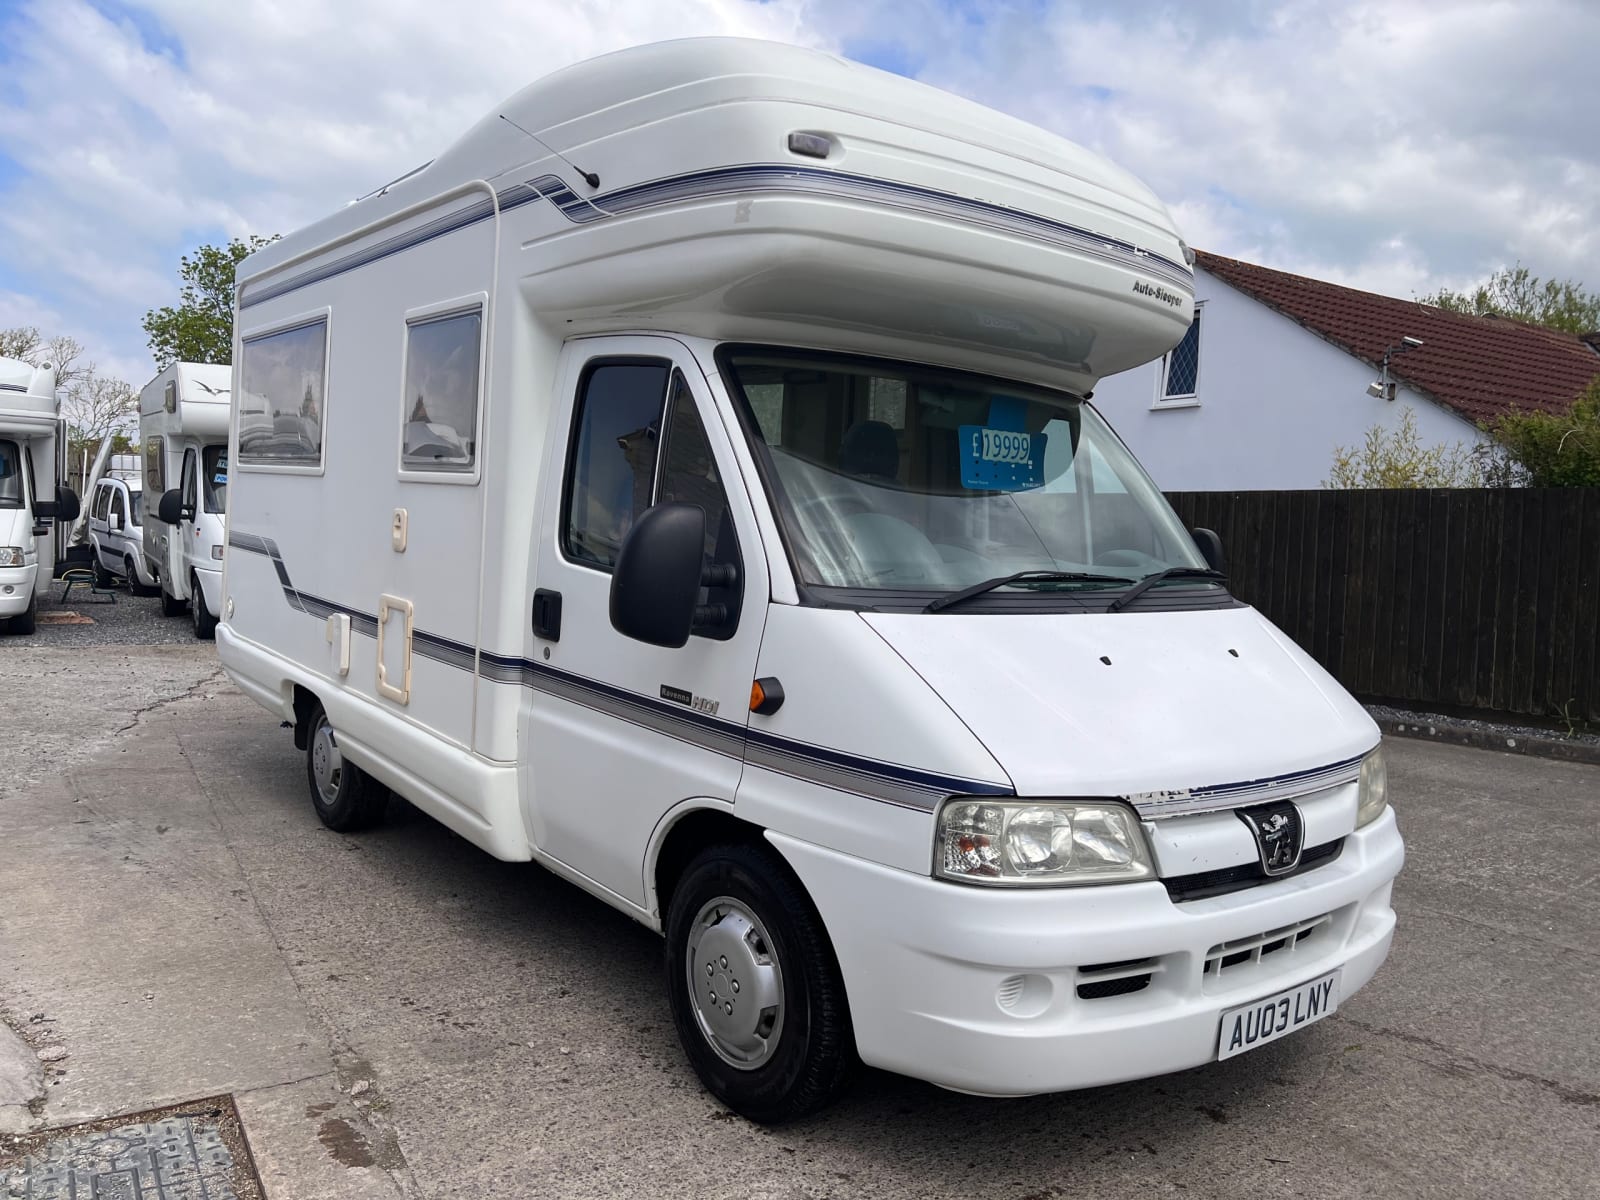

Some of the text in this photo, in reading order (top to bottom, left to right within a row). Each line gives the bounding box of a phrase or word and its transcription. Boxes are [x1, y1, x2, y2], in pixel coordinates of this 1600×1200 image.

[661, 687, 690, 703] Ravenna
[1229, 978, 1334, 1051] AU03 LNY
